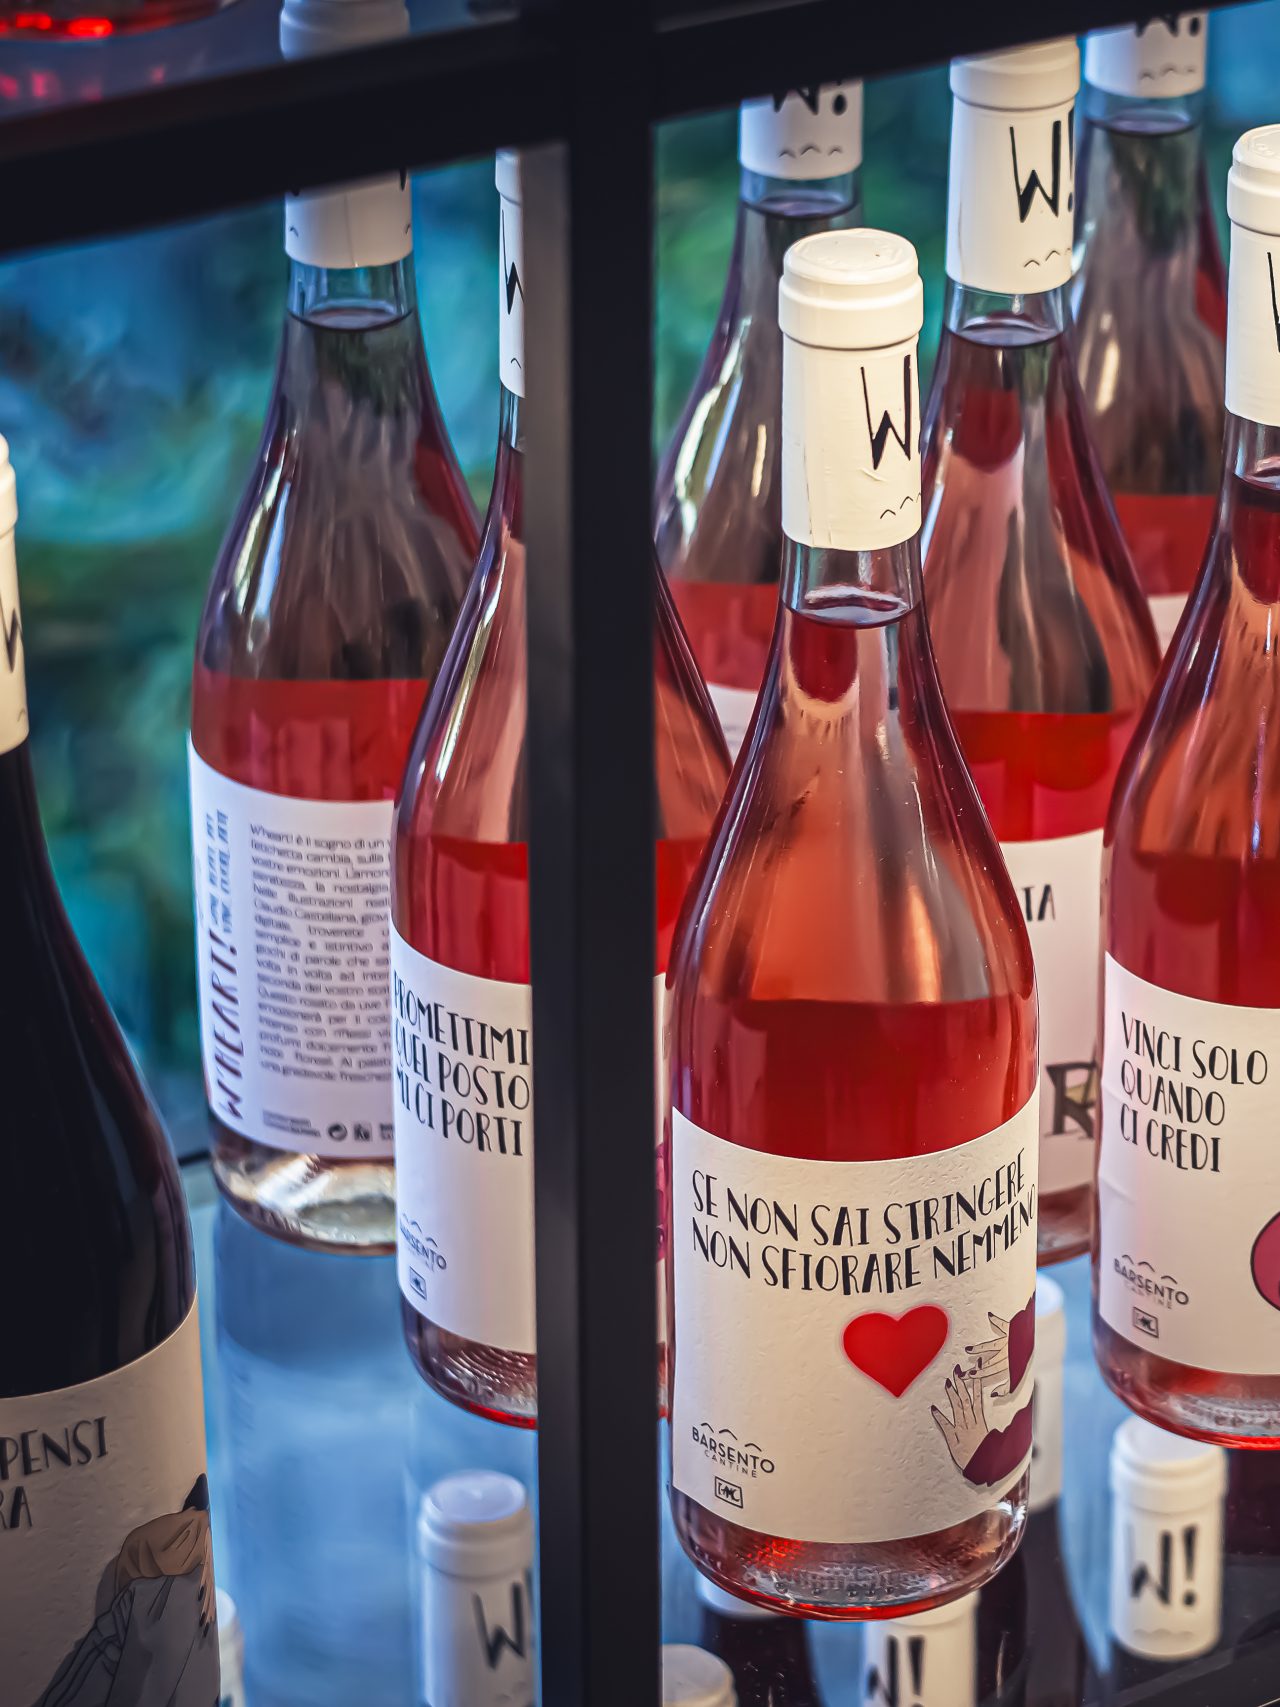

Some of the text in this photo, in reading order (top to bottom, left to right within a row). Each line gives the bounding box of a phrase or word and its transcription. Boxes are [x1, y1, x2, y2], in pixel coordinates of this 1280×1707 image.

[394, 970, 531, 1066] PROMETTIMI
[1121, 1011, 1268, 1086] VINCI SOLO
[438, 1051, 530, 1110] POSTO
[1120, 1059, 1226, 1127] QUANDO
[415, 1082, 435, 1130] CI
[441, 1099, 523, 1157] PORTI
[1120, 1103, 1221, 1174] CI CREDI
[692, 1147, 1027, 1248] SE NON SAI STRINGERE
[692, 1183, 1038, 1297] NON SFIORARE NEMMENO
[692, 1426, 775, 1474] BARSENTO
[704, 1449, 758, 1479] CANTINE
